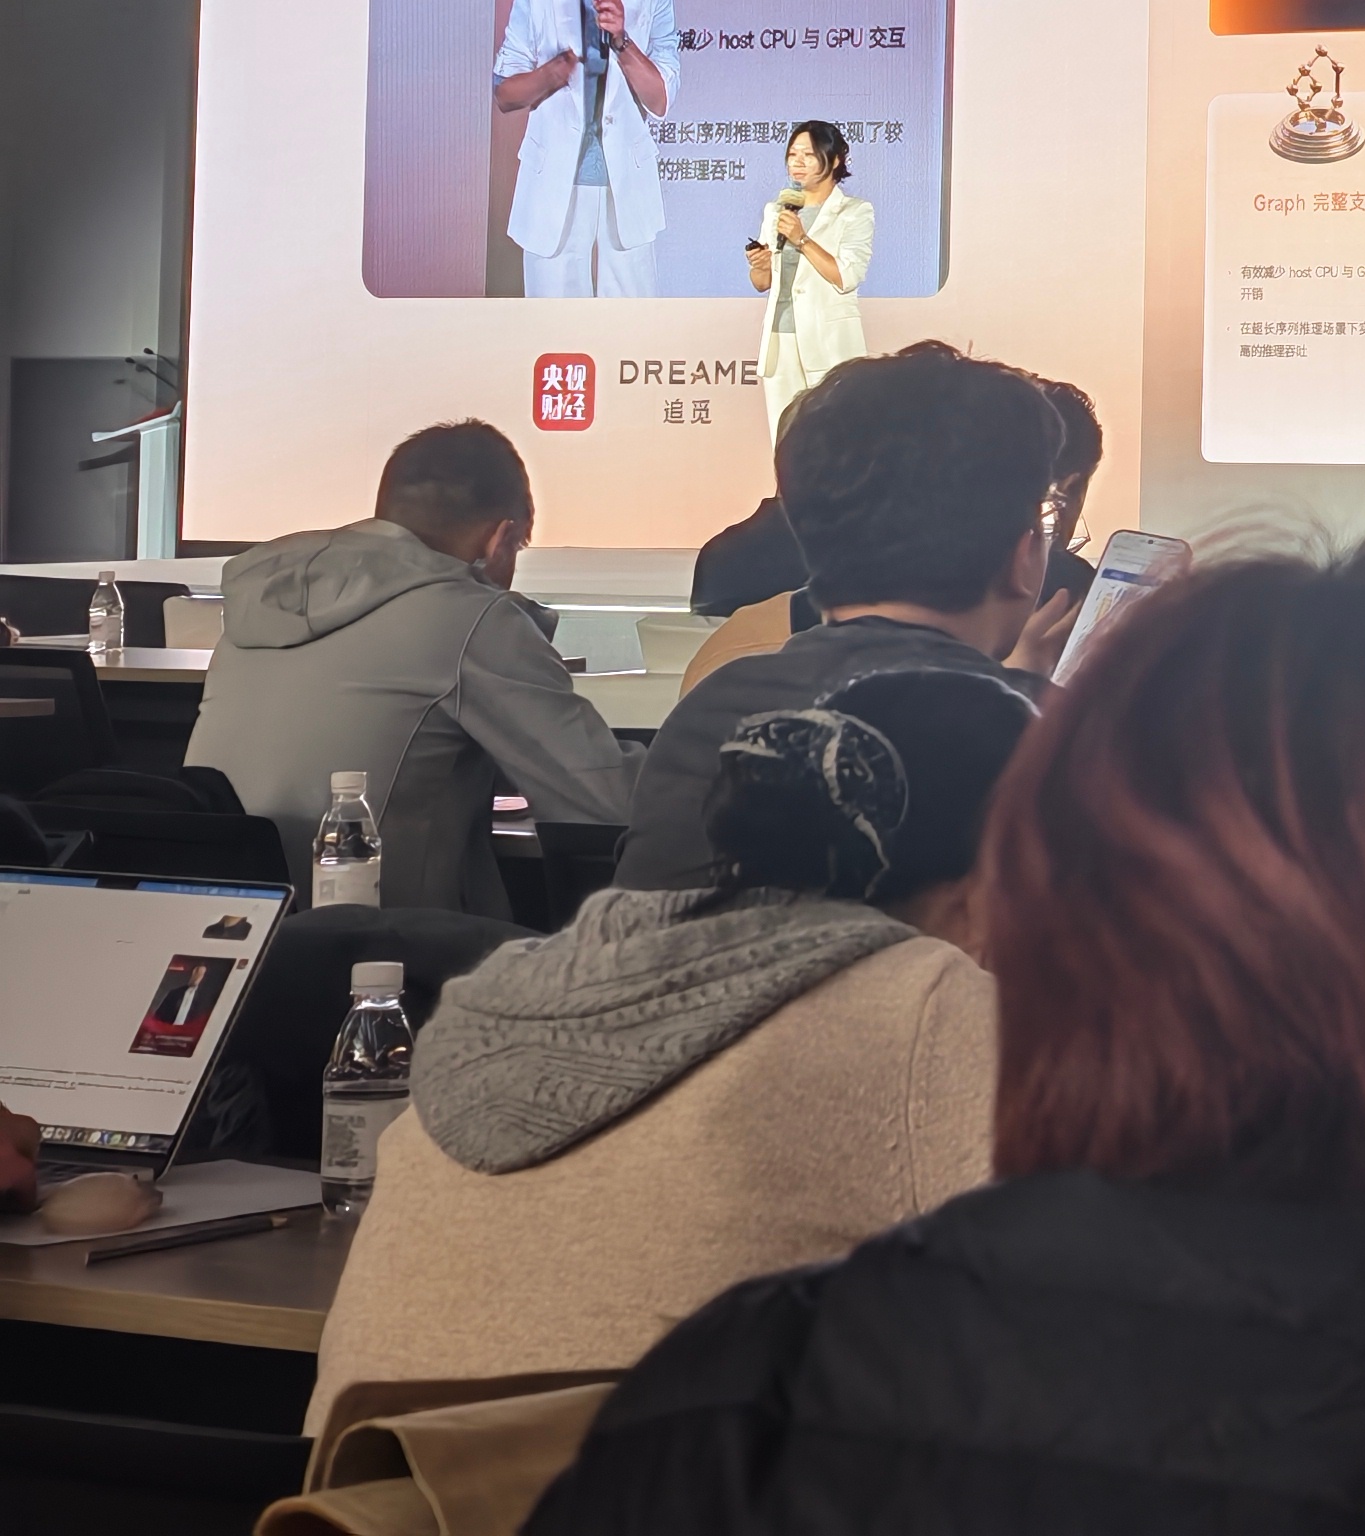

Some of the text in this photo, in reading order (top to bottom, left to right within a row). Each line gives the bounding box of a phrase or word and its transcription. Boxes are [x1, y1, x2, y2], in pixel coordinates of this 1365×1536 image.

[719, 30, 754, 49] host
[760, 29, 796, 50] CPU
[802, 28, 819, 49] 与
[826, 28, 863, 48] GPU
[869, 26, 906, 49] 交互
[1254, 194, 1305, 215] Graph
[1289, 266, 1311, 278] host
[1315, 266, 1339, 278] CPU
[1342, 266, 1353, 278] 与
[542, 364, 586, 391] 央视
[619, 360, 758, 385] DREAME
[541, 393, 586, 421] 财经
[663, 398, 712, 424] 追觅
